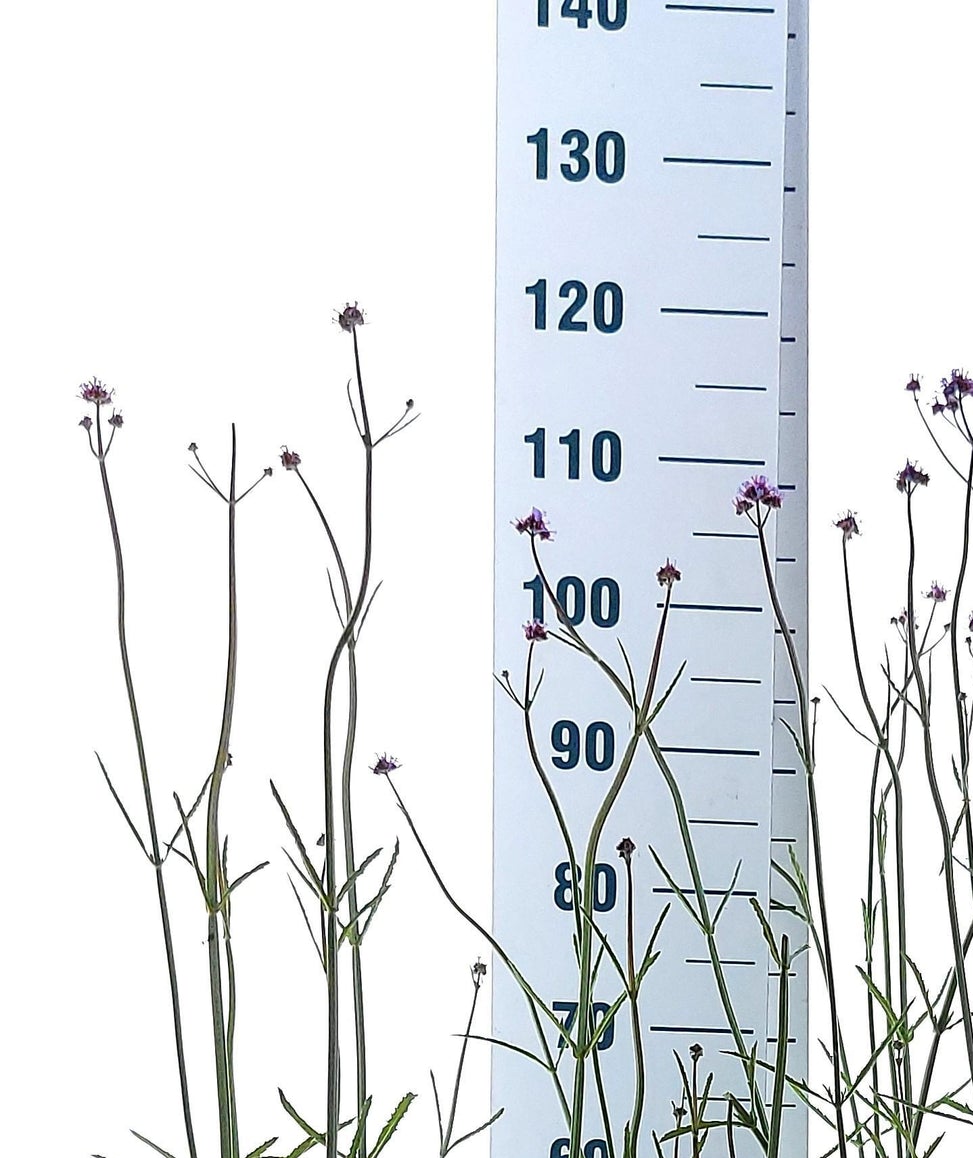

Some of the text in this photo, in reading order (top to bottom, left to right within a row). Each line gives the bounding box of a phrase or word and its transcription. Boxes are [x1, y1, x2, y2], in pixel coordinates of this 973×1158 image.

[527, 128, 625, 183] 130
[526, 279, 623, 333] 120
[525, 428, 621, 482] 110
[523, 575, 620, 628] 100
[551, 720, 614, 771] 90
[553, 861, 617, 912] 80
[552, 1001, 614, 1051] 70
